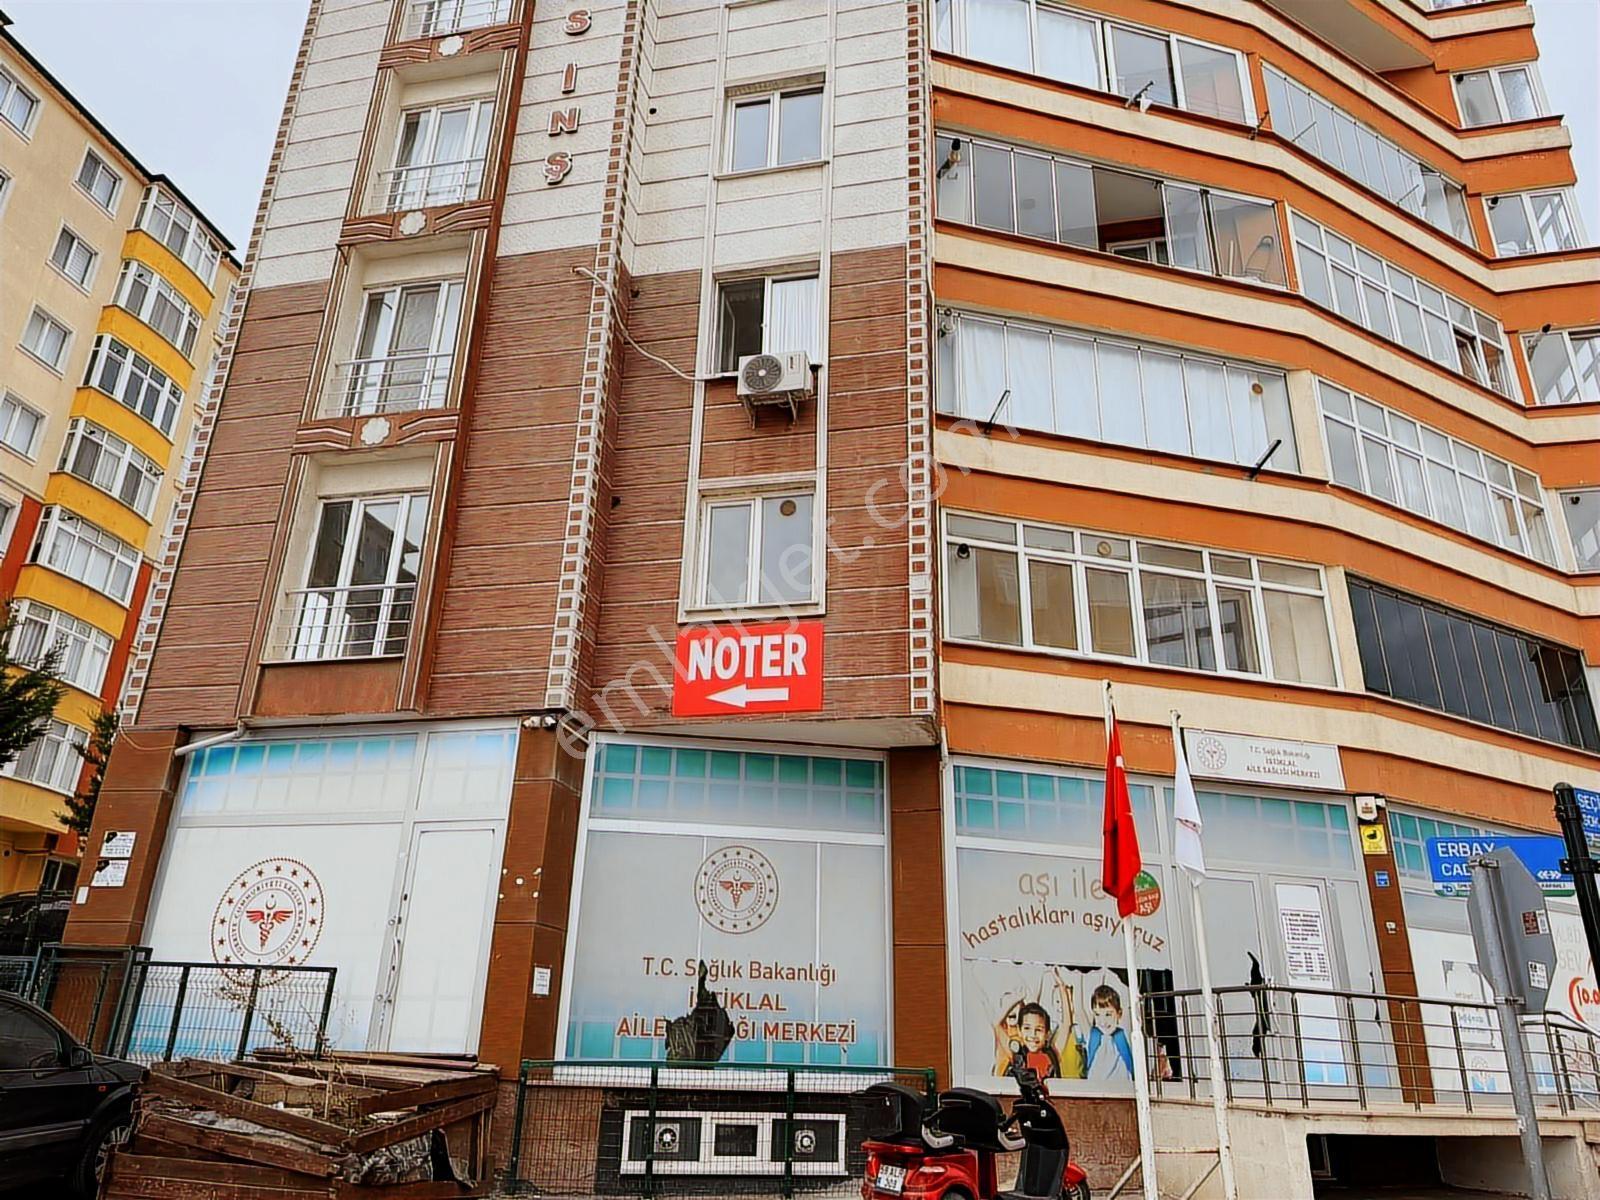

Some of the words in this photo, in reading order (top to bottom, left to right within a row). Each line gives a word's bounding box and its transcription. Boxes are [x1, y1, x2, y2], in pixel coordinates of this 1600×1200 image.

[687, 634, 808, 681] NOTER
[1437, 843, 1494, 857] ERBAY
[1019, 874, 1058, 902] aşı
[1072, 867, 1106, 900] ile
[963, 904, 1075, 948] hastalıkları
[643, 957, 678, 976] T.C.
[684, 959, 742, 982] Sğlık
[749, 961, 836, 986] Bakanlığı
[689, 986, 787, 1011] İİKLAL
[616, 1012, 667, 1037] AİLE
[763, 1018, 856, 1043] MERKEZİ
